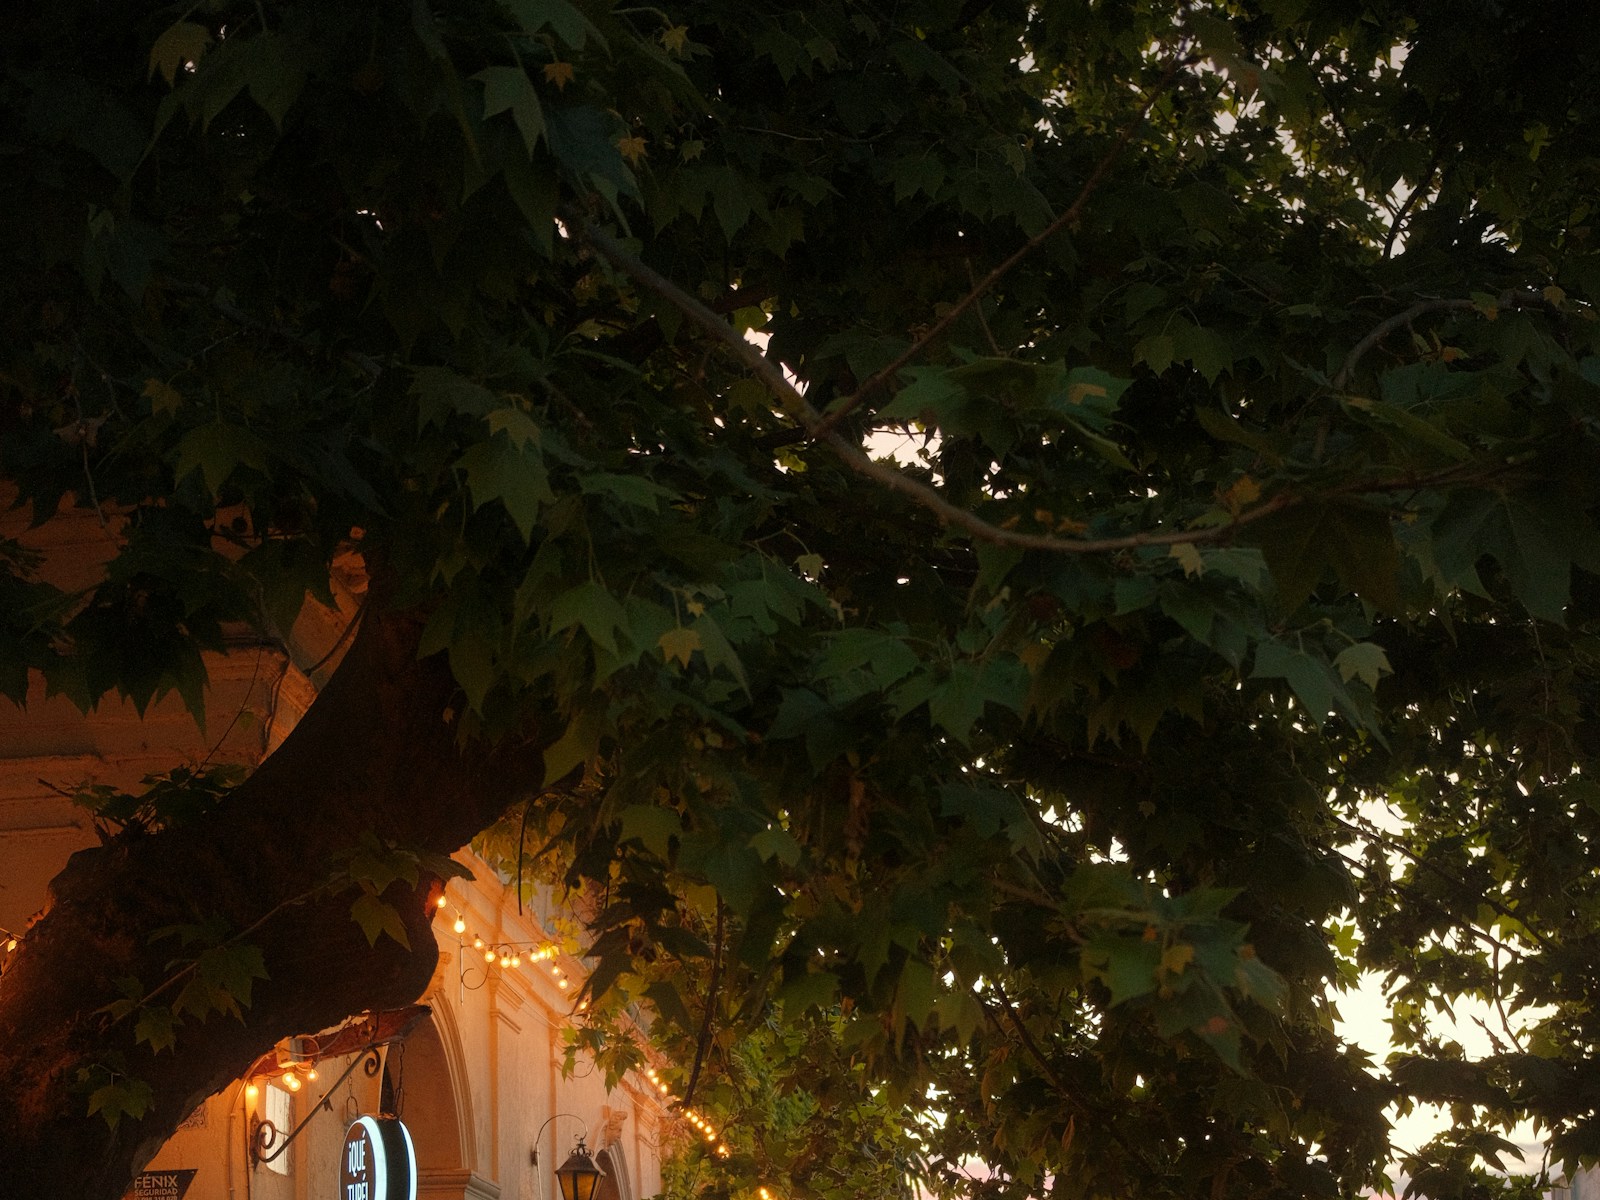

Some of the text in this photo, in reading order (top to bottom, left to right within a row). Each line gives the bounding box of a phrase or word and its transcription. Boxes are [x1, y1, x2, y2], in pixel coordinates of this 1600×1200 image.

[348, 1130, 366, 1177] ¡QUÉ
[134, 1173, 178, 1188] FÉNIX
[134, 1188, 178, 1196] SEGURIDAD
